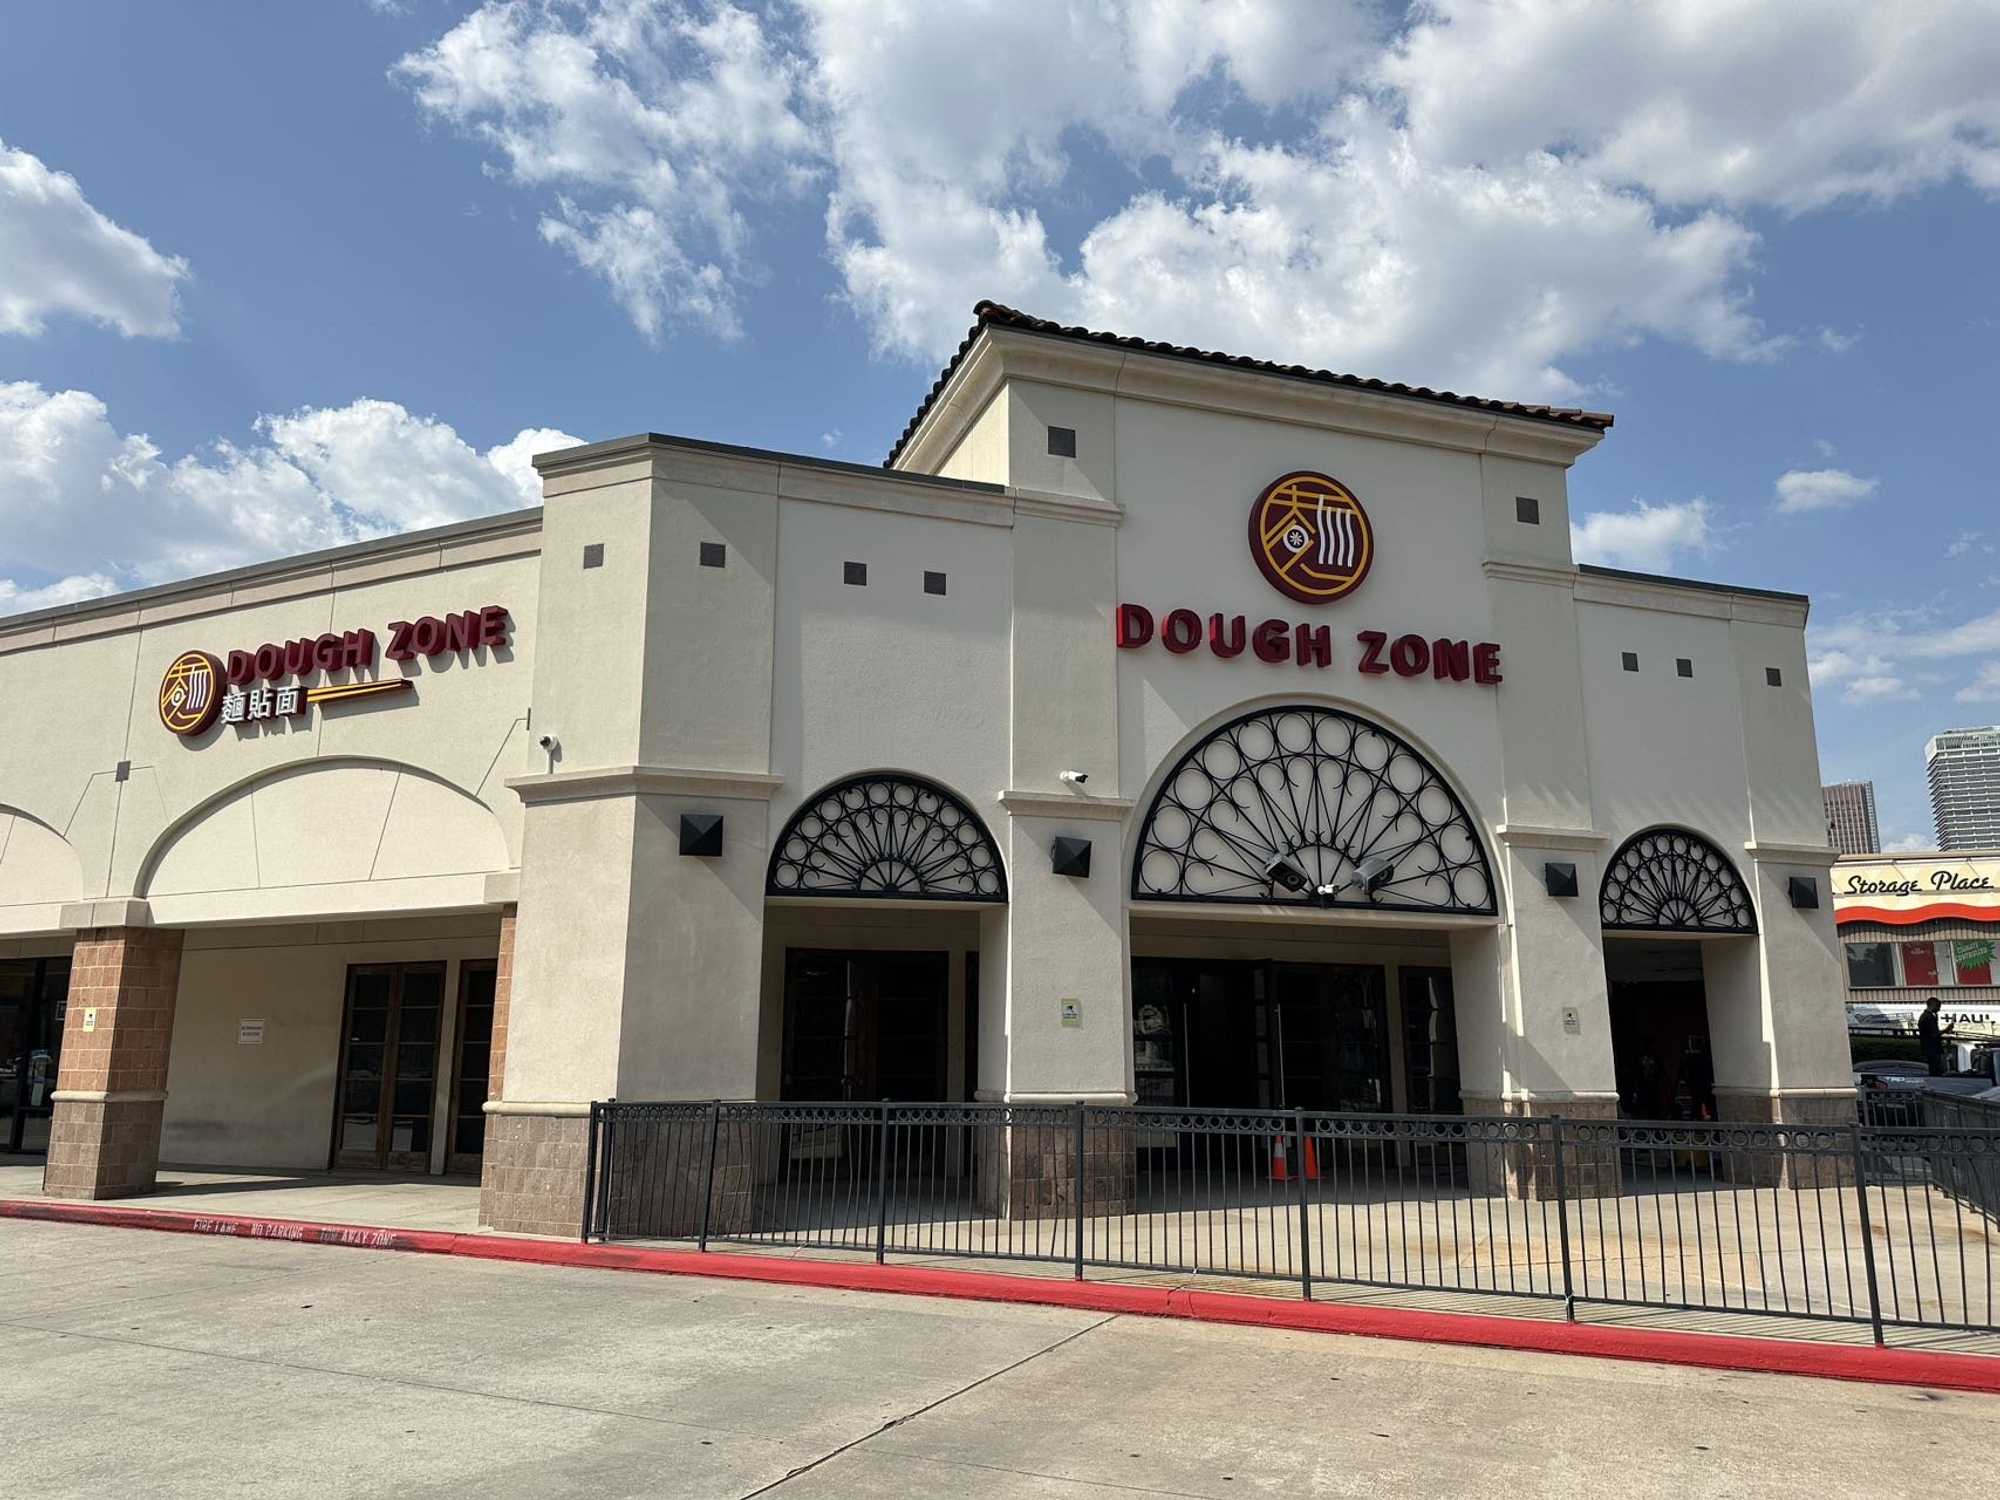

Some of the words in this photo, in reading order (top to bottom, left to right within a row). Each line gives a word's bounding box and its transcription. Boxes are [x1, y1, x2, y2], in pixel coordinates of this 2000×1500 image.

[227, 628, 375, 685] DOUGH
[385, 605, 510, 660] ZONE
[1116, 603, 1332, 668] DOUGH
[1357, 630, 1503, 685] ZONE
[221, 685, 300, 724] 麵貼面
[1844, 875, 1923, 897] Storage
[1930, 870, 1994, 891] Place
[193, 1218, 213, 1232] FIRE
[250, 1223, 264, 1237] NO
[265, 1224, 304, 1241] PARKING
